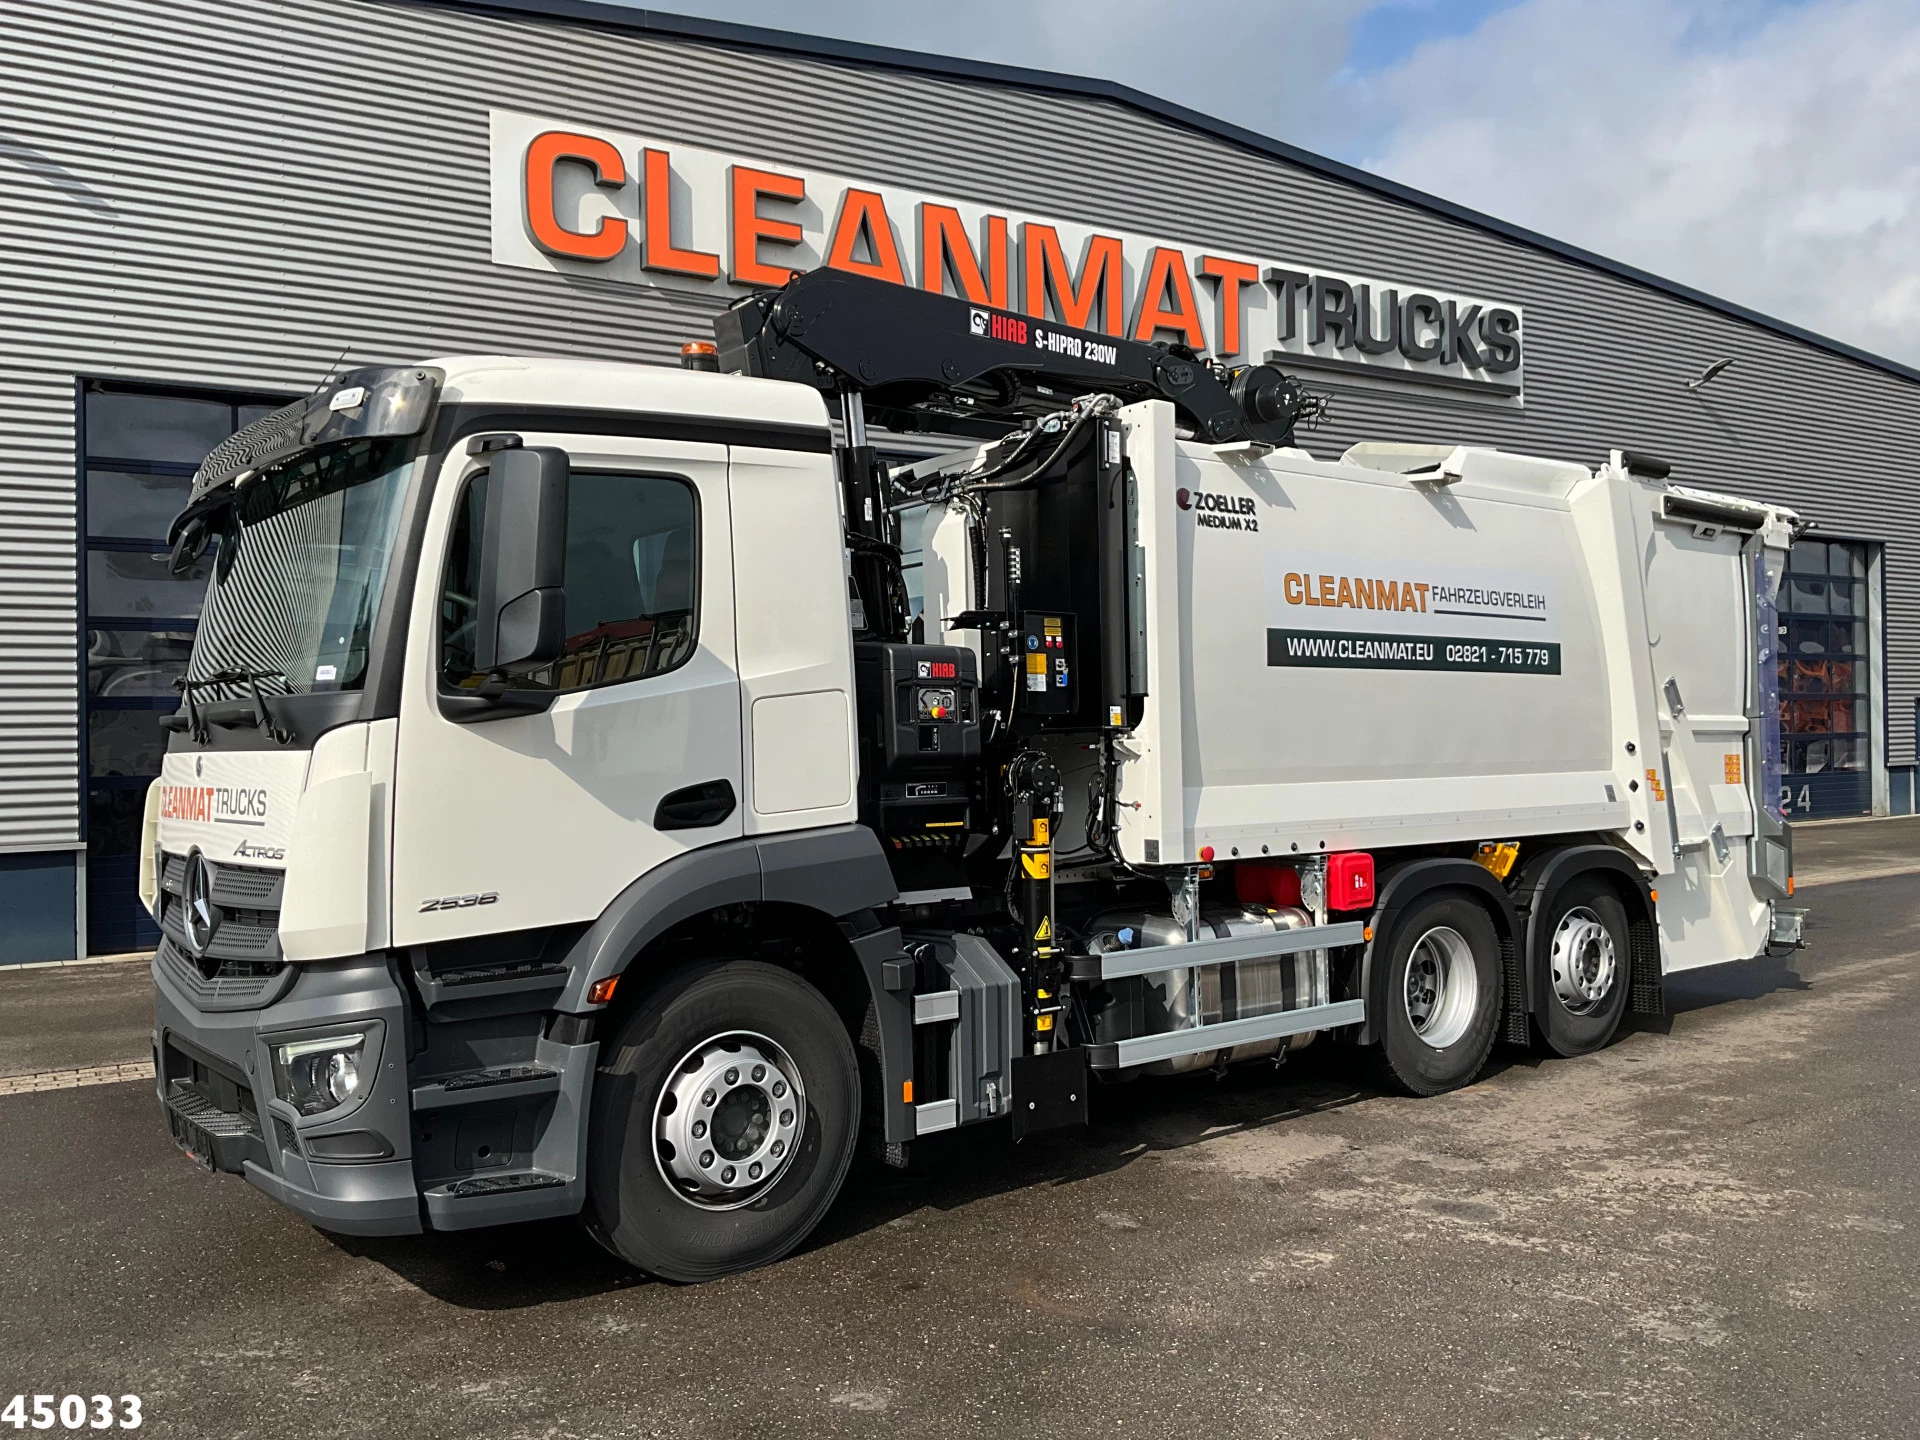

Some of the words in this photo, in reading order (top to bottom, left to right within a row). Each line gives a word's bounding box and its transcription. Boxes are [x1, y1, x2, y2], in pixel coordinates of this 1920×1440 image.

[521, 130, 1259, 357] CLEANMAT
[1263, 266, 1521, 373] TRUCKS
[991, 314, 1027, 345] HIAB
[1035, 329, 1081, 357] S-HIPRO
[1084, 341, 1117, 365] 230W
[1193, 491, 1256, 516] ZOELLER
[1197, 513, 1242, 530] MEDIUM
[1244, 518, 1259, 532] X2
[1284, 572, 1429, 613] CLEANMAT
[1432, 586, 1546, 610] FAHRZEUGVERLEIH
[1287, 638, 1433, 661] WWW.CLEANMAT.EU
[1446, 645, 1487, 663] 02821
[1499, 648, 1522, 664] 715
[1526, 649, 1549, 665] 779
[932, 663, 955, 677] HIAB
[215, 788, 267, 816] TRUCKS
[1779, 784, 1811, 812] 24
[418, 891, 499, 913] 2536
